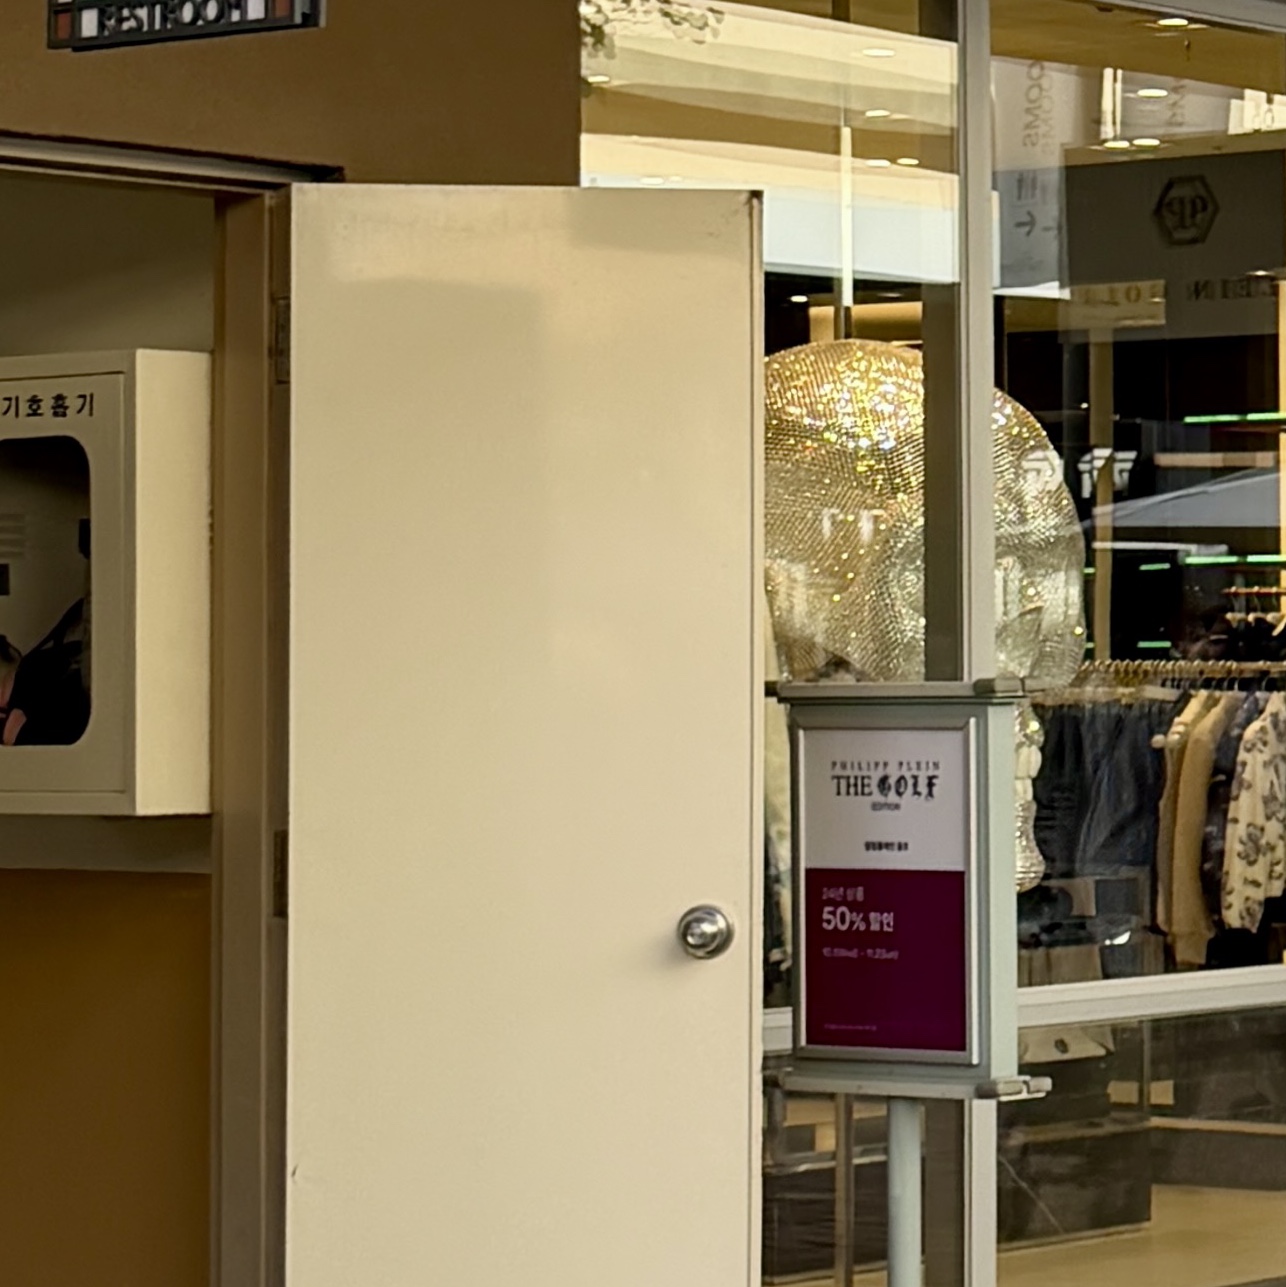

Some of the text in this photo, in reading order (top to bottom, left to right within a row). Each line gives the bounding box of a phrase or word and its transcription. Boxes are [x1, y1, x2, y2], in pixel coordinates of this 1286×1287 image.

[831, 761, 940, 772] PHILIPP PLEIN
[831, 773, 940, 800] THE GOLF
[822, 905, 866, 931] 50%
